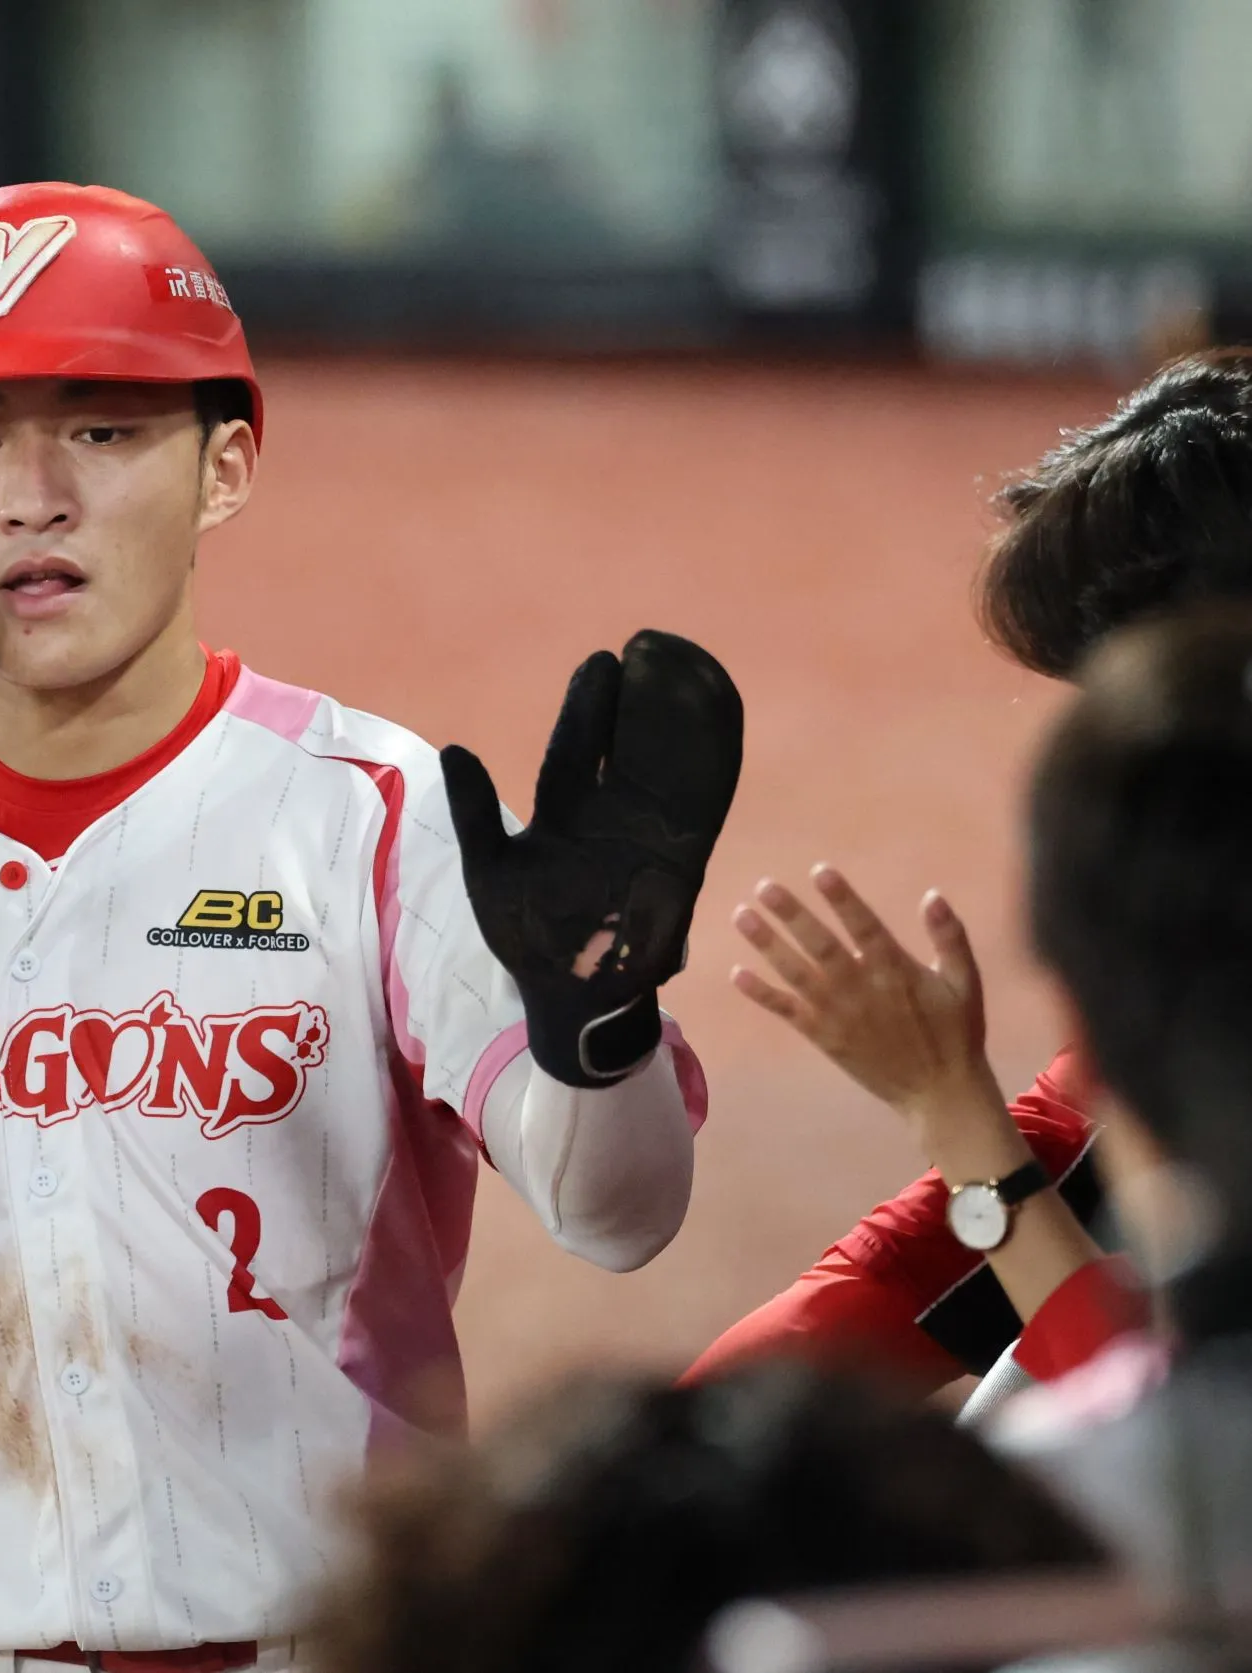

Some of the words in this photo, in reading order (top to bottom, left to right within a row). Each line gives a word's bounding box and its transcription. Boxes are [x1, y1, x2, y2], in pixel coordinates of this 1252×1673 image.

[176, 890, 283, 931] BC
[148, 929, 233, 947] COILOVER
[195, 1186, 289, 1321] 2
